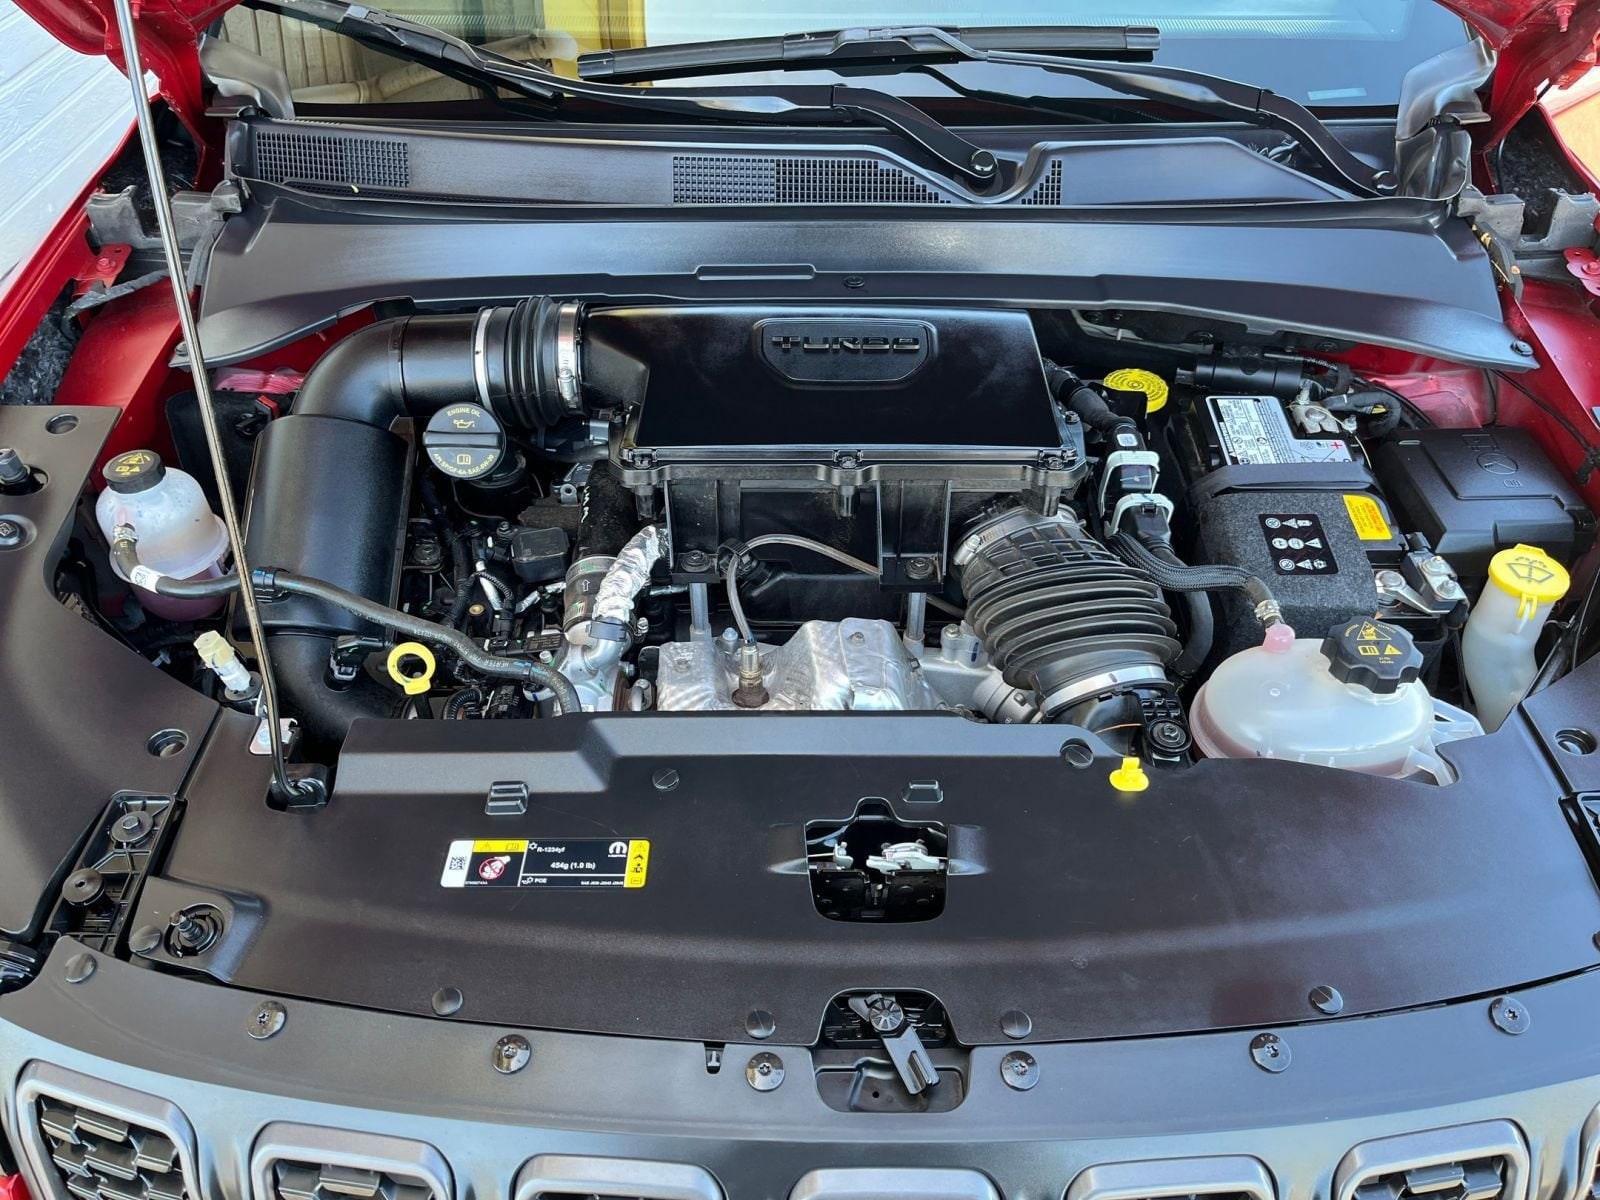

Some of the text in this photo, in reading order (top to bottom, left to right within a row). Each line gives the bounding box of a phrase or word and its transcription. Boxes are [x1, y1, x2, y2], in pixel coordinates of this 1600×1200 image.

[771, 335, 921, 352] TURBO
[447, 407, 480, 418] ENGINE OIL
[550, 862, 596, 870] 454g (1.0 lb)
